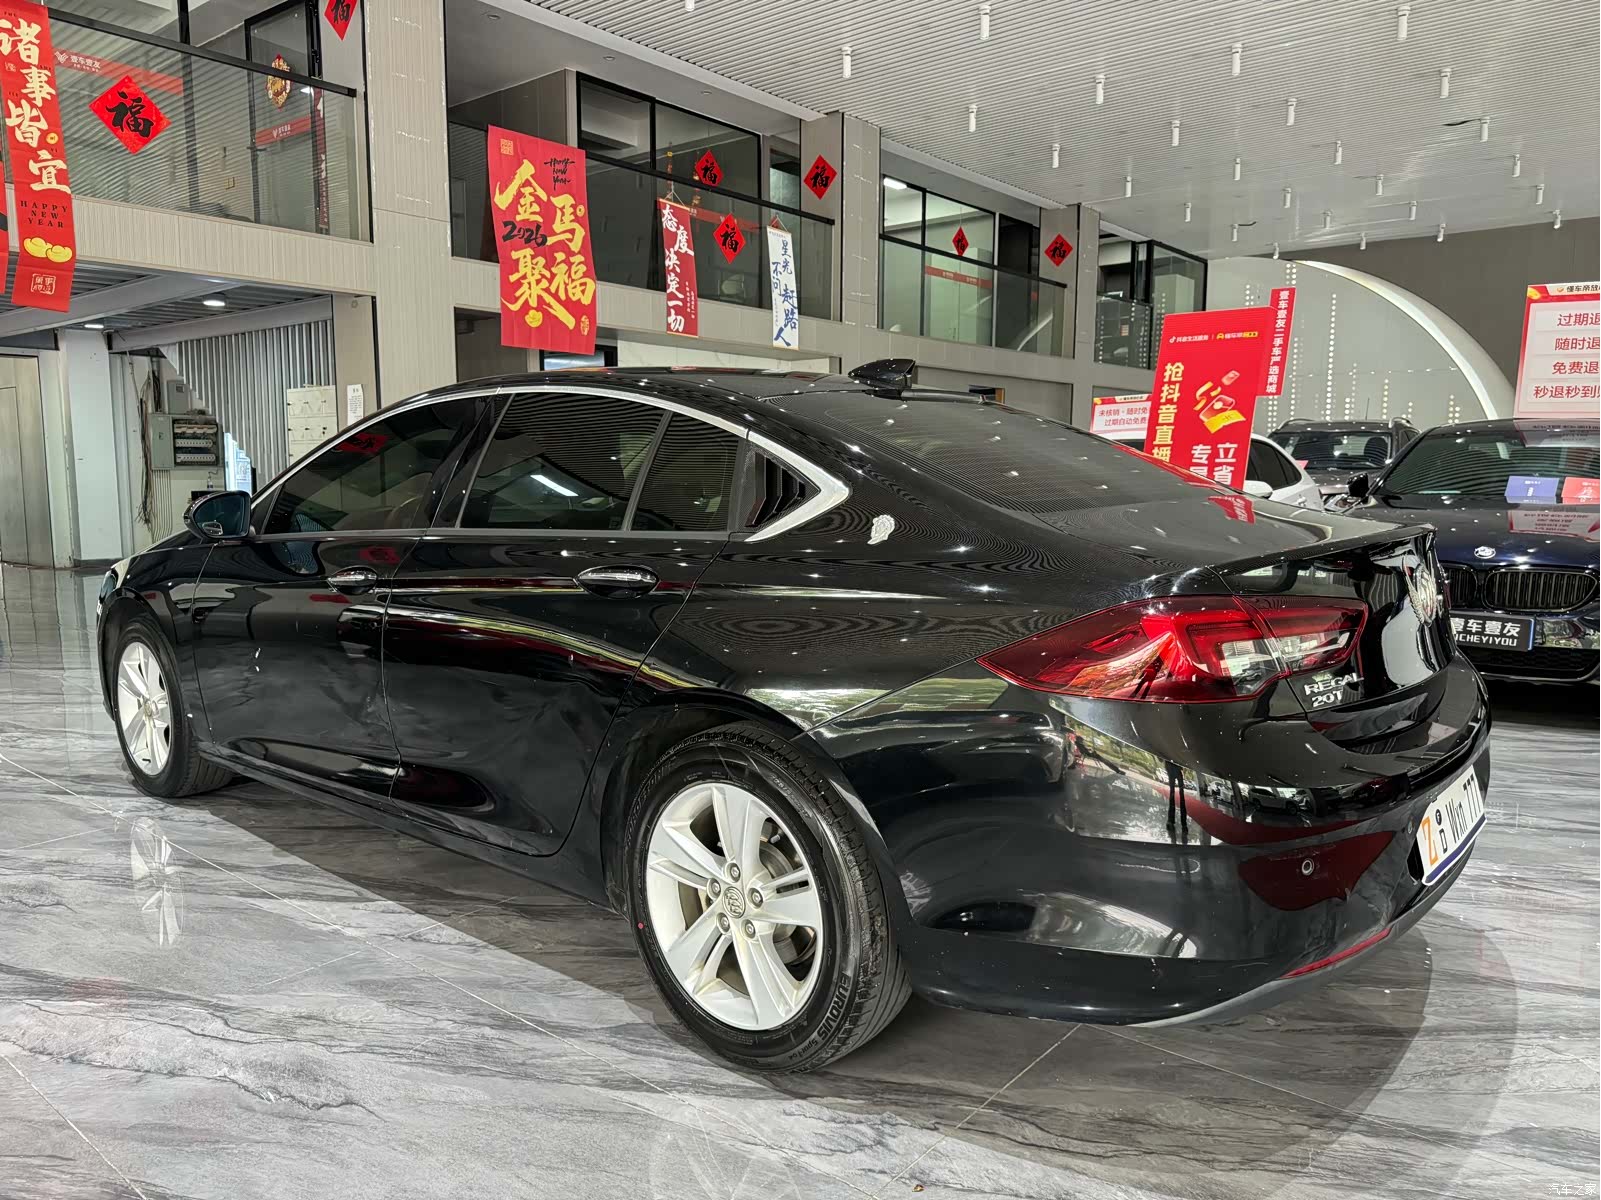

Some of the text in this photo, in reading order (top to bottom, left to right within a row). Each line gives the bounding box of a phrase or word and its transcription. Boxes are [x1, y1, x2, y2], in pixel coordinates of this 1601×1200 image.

[105, 90, 154, 138] 福
[701, 158, 718, 185] 福
[810, 164, 831, 188] 福
[20, 200, 68, 213] HAPPY
[31, 210, 59, 220] NEW
[28, 217, 65, 229] YEAR
[501, 220, 549, 248] 2026
[720, 223, 740, 253] 福
[1566, 284, 1600, 293] 懂车帝放
[1304, 672, 1365, 696] REGAL
[1311, 690, 1344, 708] 20T
[815, 971, 852, 1041] EUROVIS
